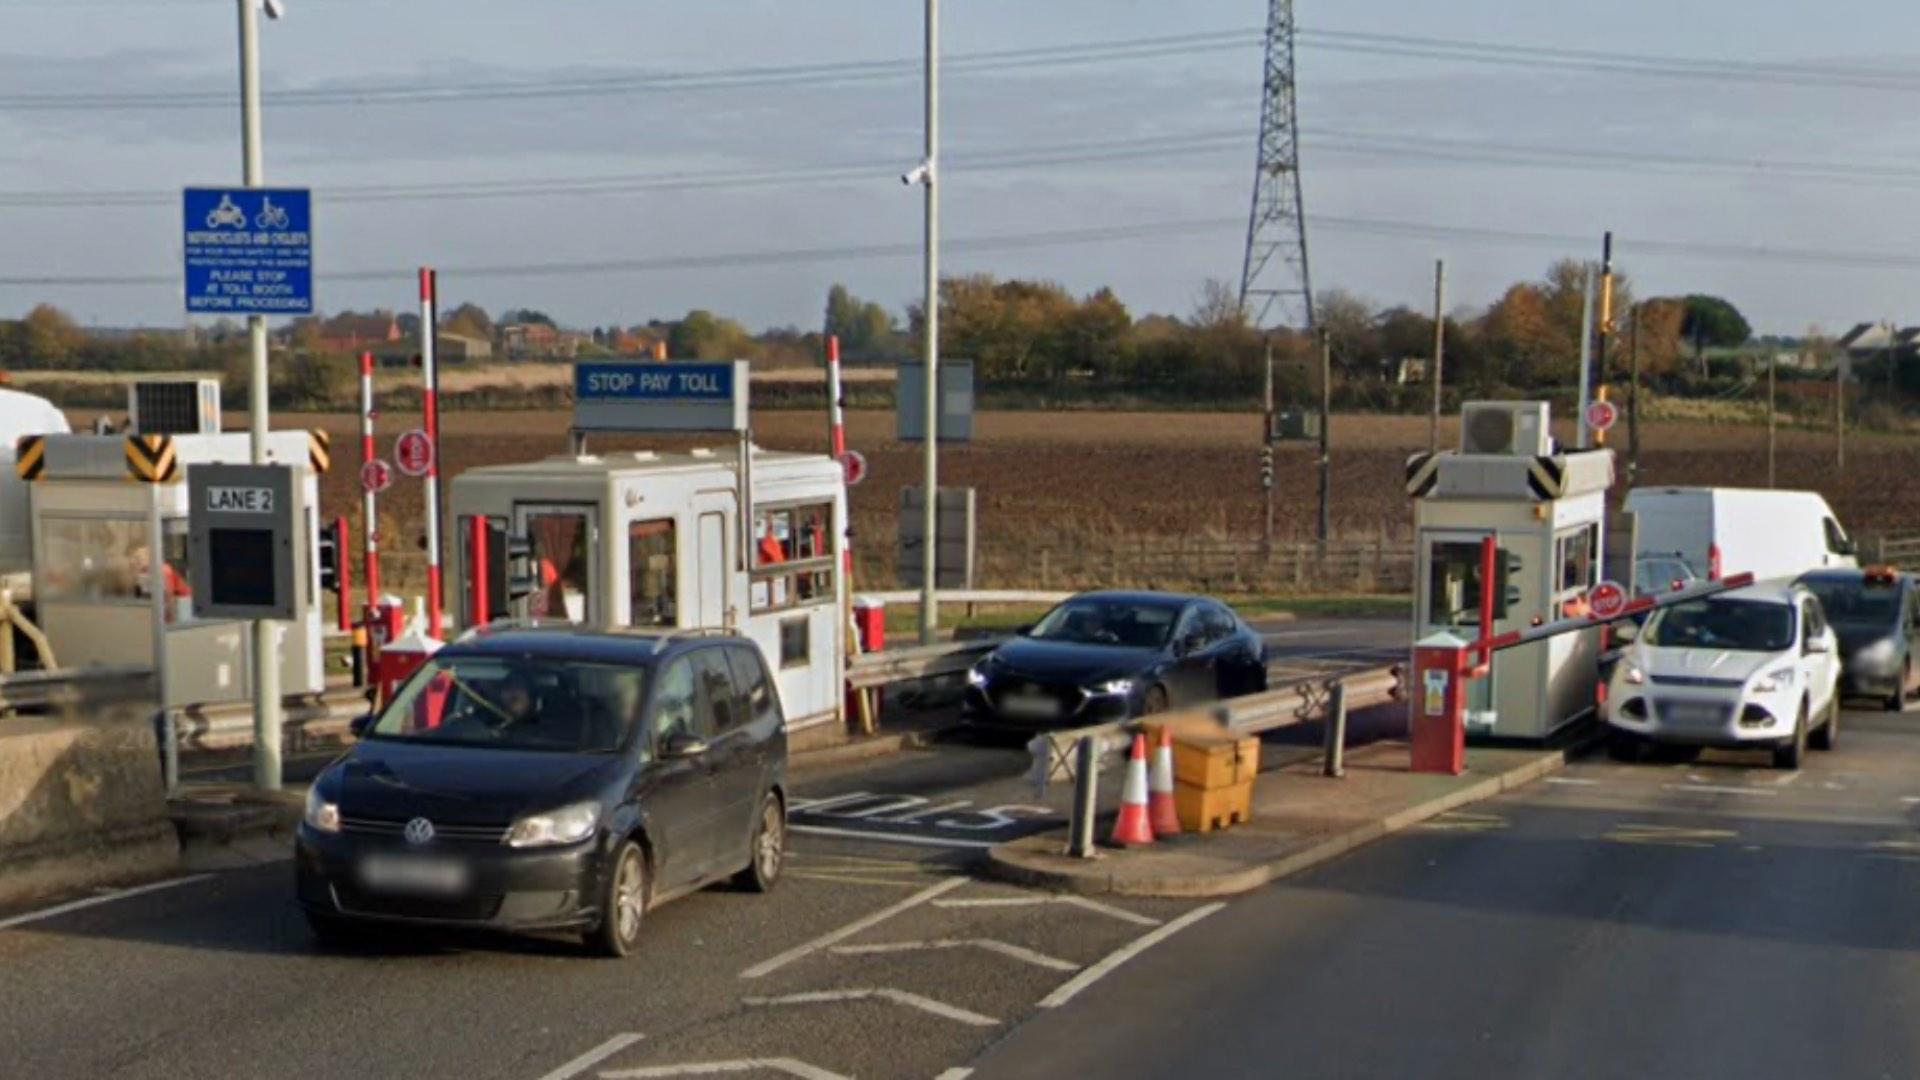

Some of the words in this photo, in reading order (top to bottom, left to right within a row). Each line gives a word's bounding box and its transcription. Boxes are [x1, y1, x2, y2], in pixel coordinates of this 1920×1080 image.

[209, 270, 254, 282] PLEASE
[256, 270, 287, 282] STOP
[206, 283, 219, 295] AT
[222, 283, 250, 295] TOLL
[253, 283, 294, 295] BOOTH
[189, 296, 232, 308] BEFORE
[237, 297, 308, 308] PROCEEDING
[588, 372, 634, 392] STOP
[640, 372, 673, 392] PAY
[679, 373, 719, 392] TOLL
[208, 490, 257, 509] LANE
[261, 491, 271, 510] 2
